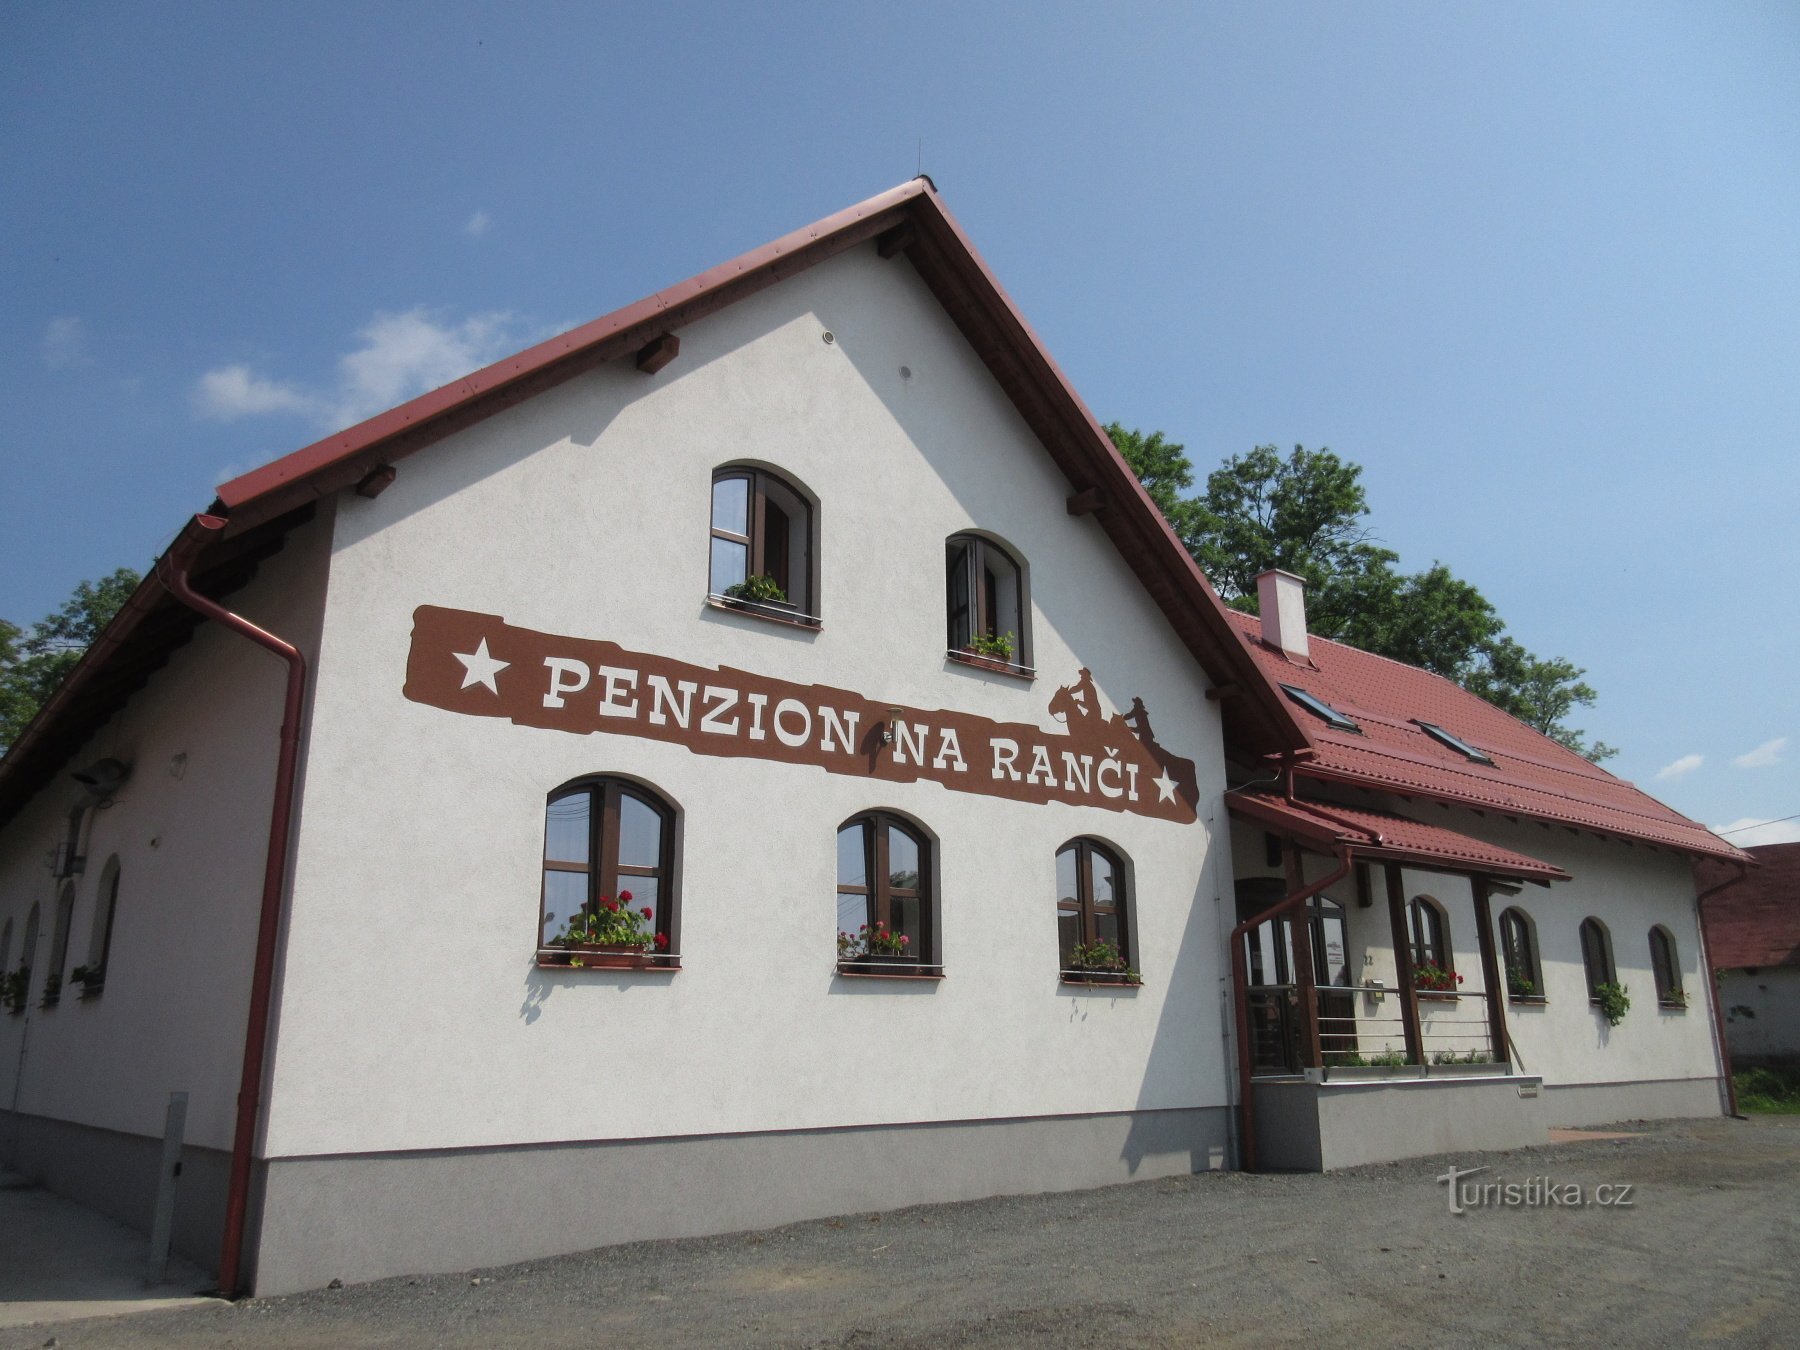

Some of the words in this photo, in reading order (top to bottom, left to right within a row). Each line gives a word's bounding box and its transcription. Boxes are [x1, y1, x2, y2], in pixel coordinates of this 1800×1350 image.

[542, 655, 860, 755] PENZION
[892, 720, 968, 772] NA
[989, 738, 1139, 802] RANČI
